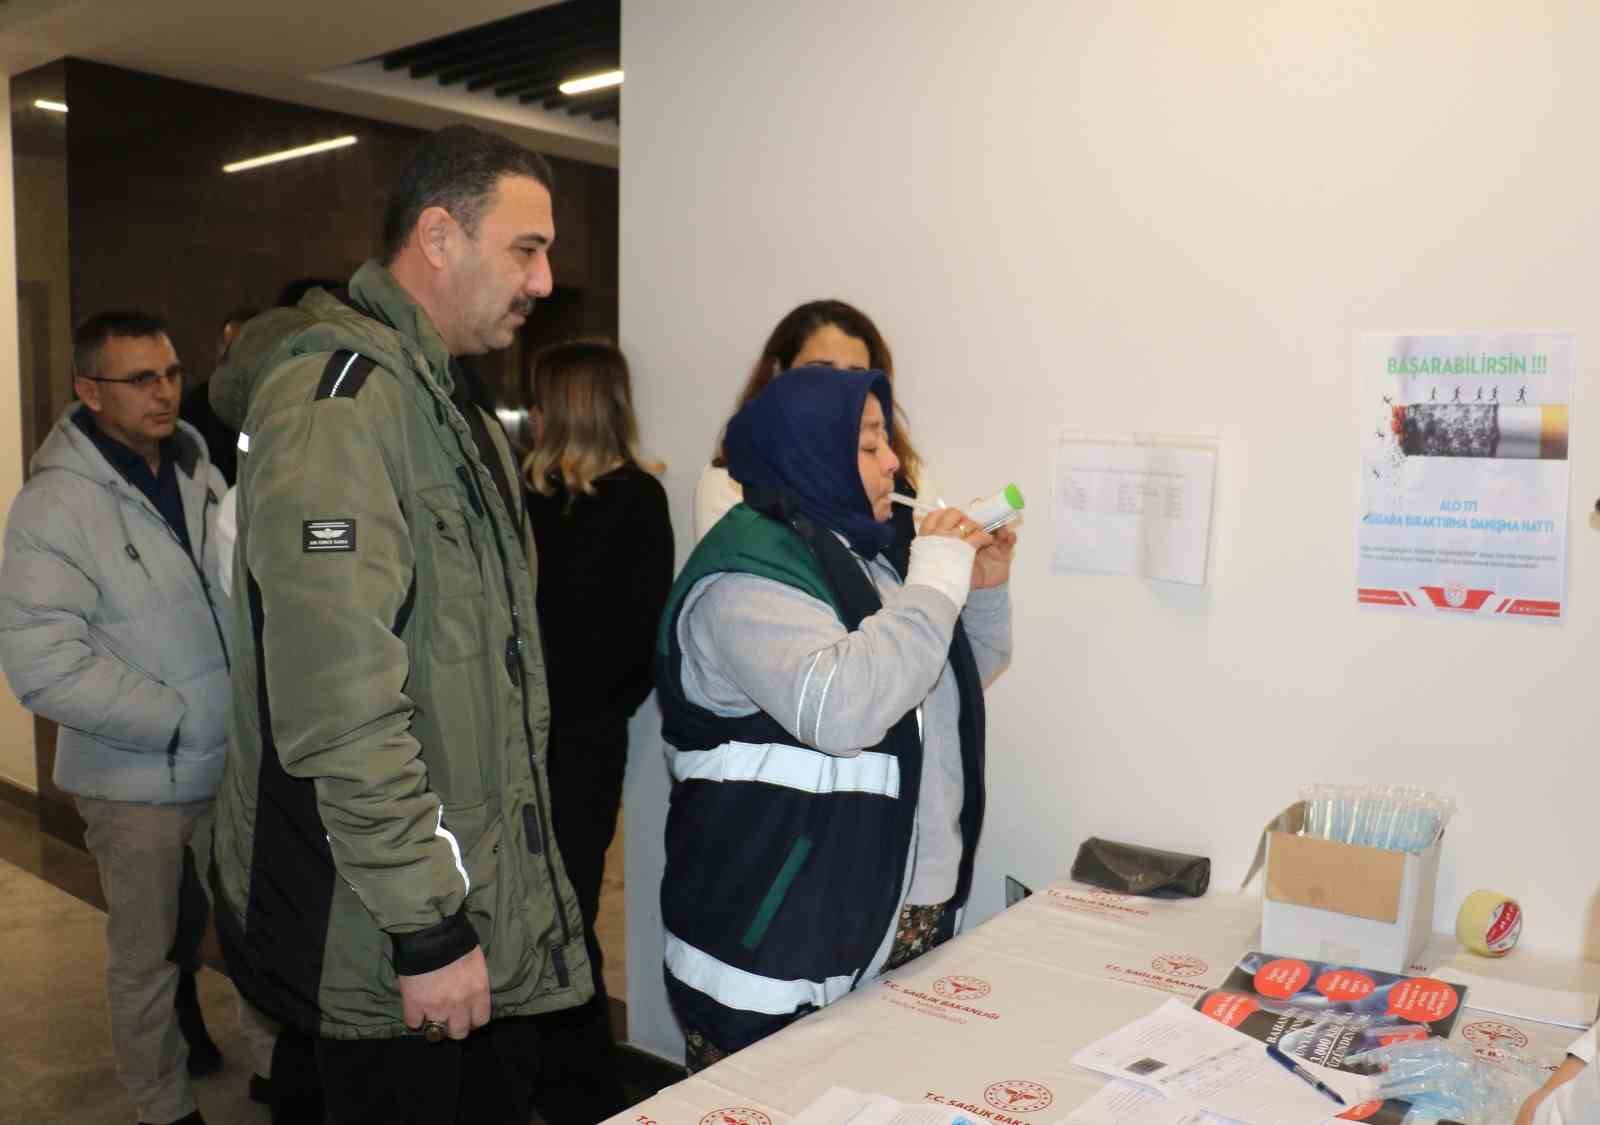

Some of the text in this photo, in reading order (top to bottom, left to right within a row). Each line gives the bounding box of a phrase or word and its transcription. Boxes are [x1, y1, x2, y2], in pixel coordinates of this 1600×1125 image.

[1387, 352, 1548, 379] BAŞARABİLİRSİN !!!
[1439, 500, 1462, 512] ALO
[925, 1092, 947, 1104] T.C.
[949, 1099, 993, 1118] SAĞLIK
